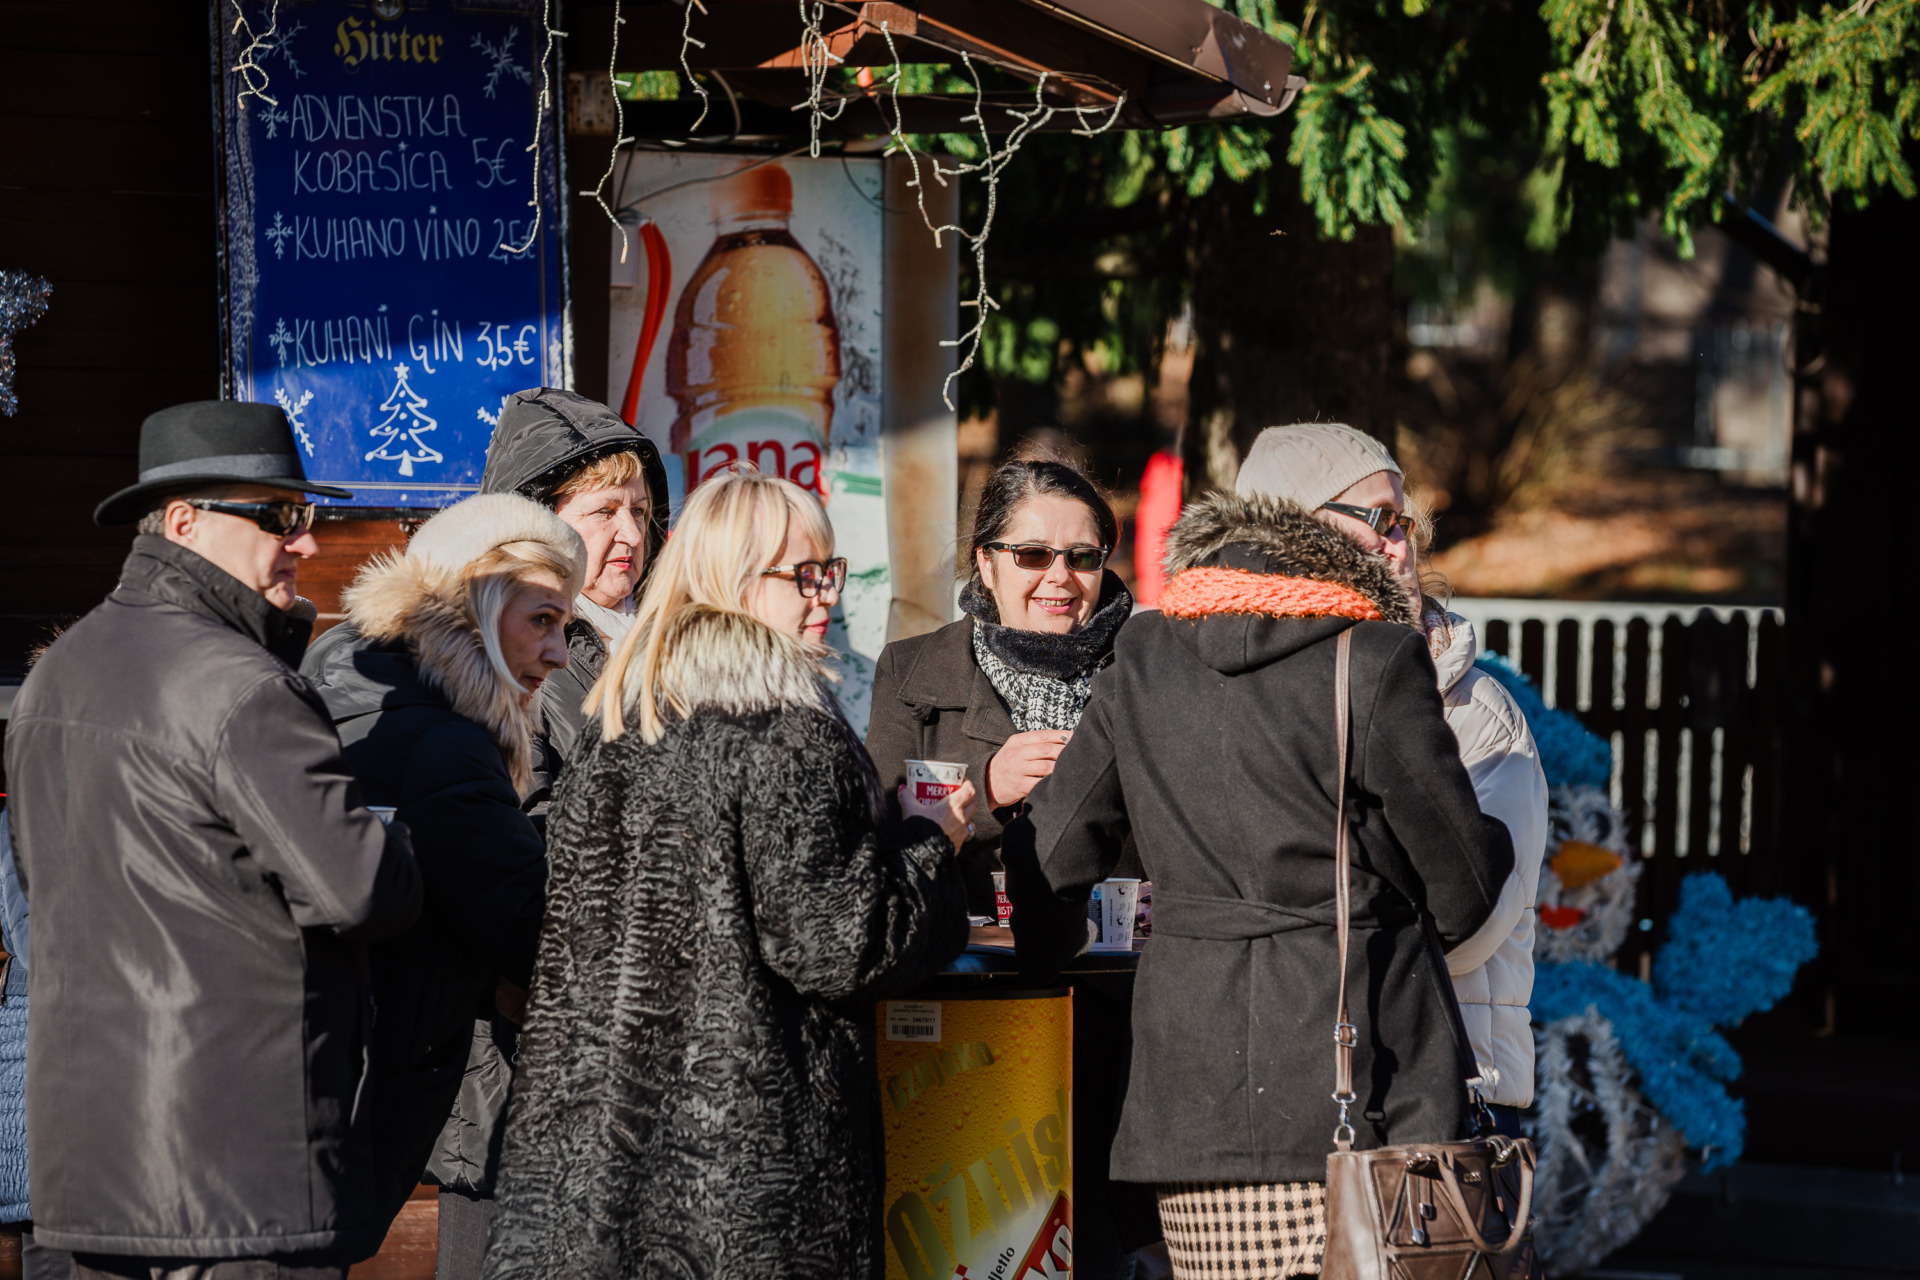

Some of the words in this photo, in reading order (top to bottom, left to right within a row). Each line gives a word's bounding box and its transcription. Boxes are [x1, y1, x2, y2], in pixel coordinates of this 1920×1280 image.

[333, 15, 444, 74] Hirter
[290, 94, 467, 142] ADVENSTKA
[472, 137, 517, 189] 5€
[294, 214, 405, 262] KUHANO
